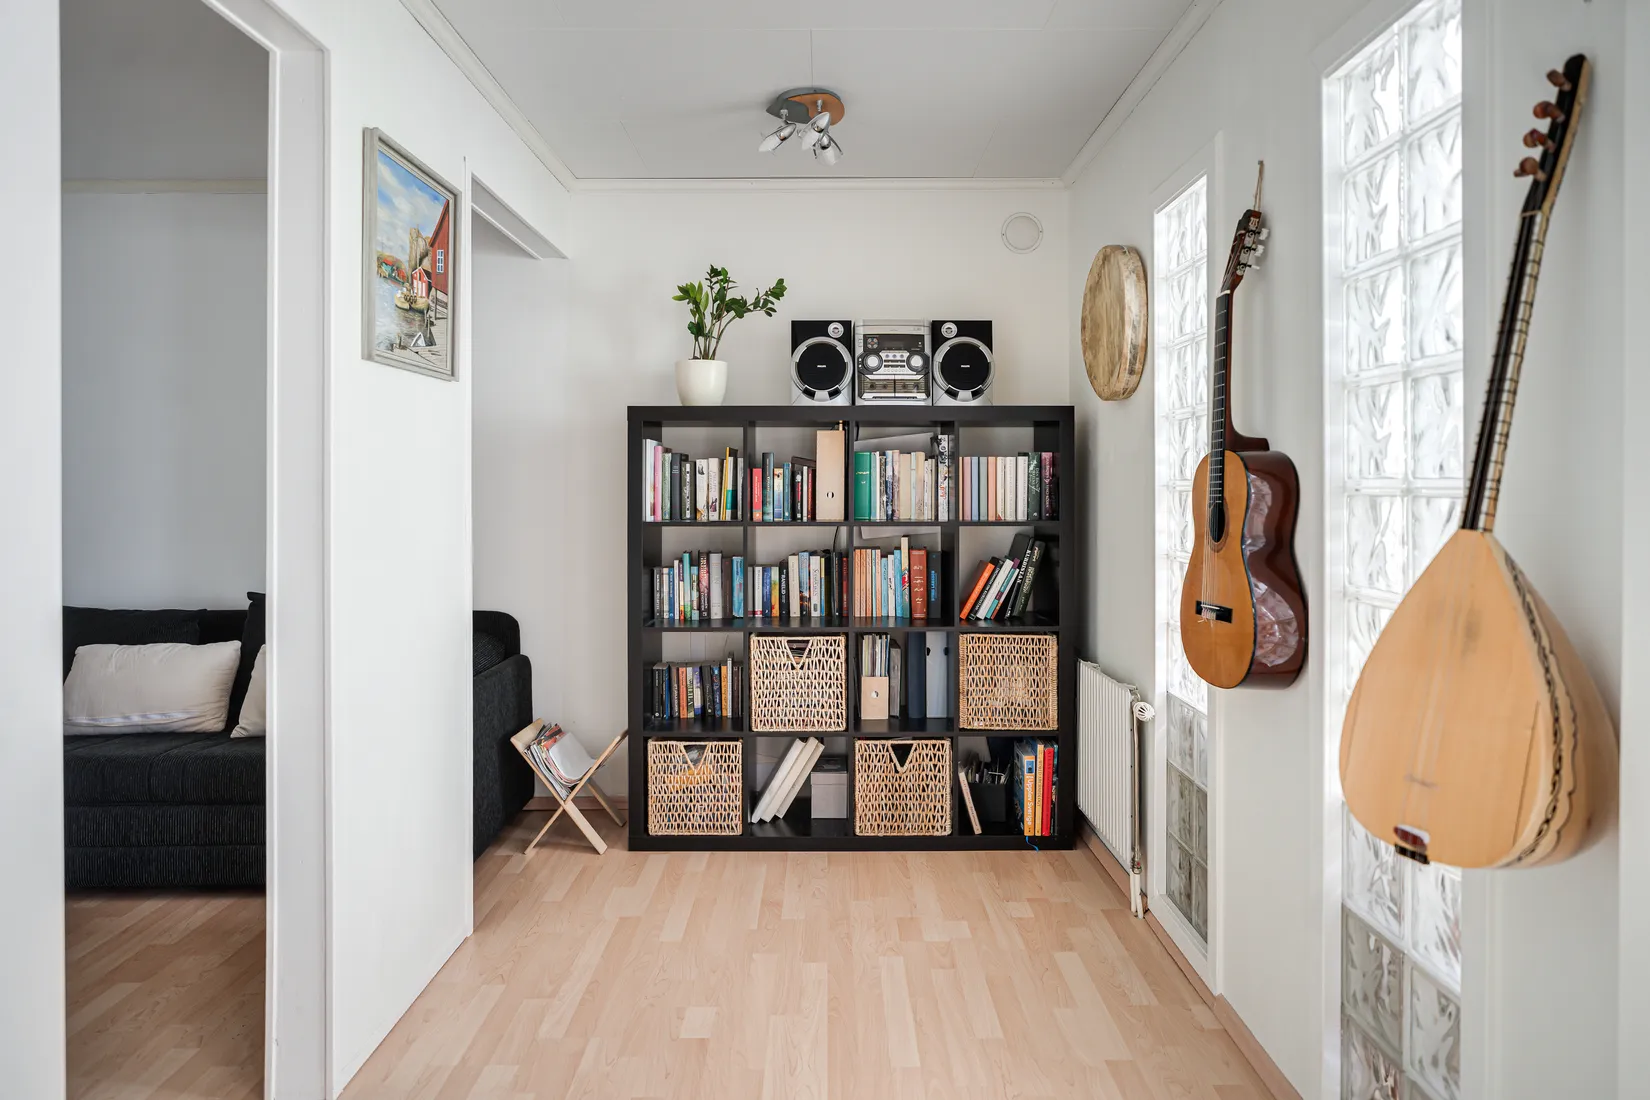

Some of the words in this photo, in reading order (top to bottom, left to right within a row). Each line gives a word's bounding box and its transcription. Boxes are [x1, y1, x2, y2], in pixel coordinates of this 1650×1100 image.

[1016, 549, 1032, 583] KURDISTAN
[1026, 779, 1034, 800] Upplev
[1026, 802, 1034, 826] Sverige
